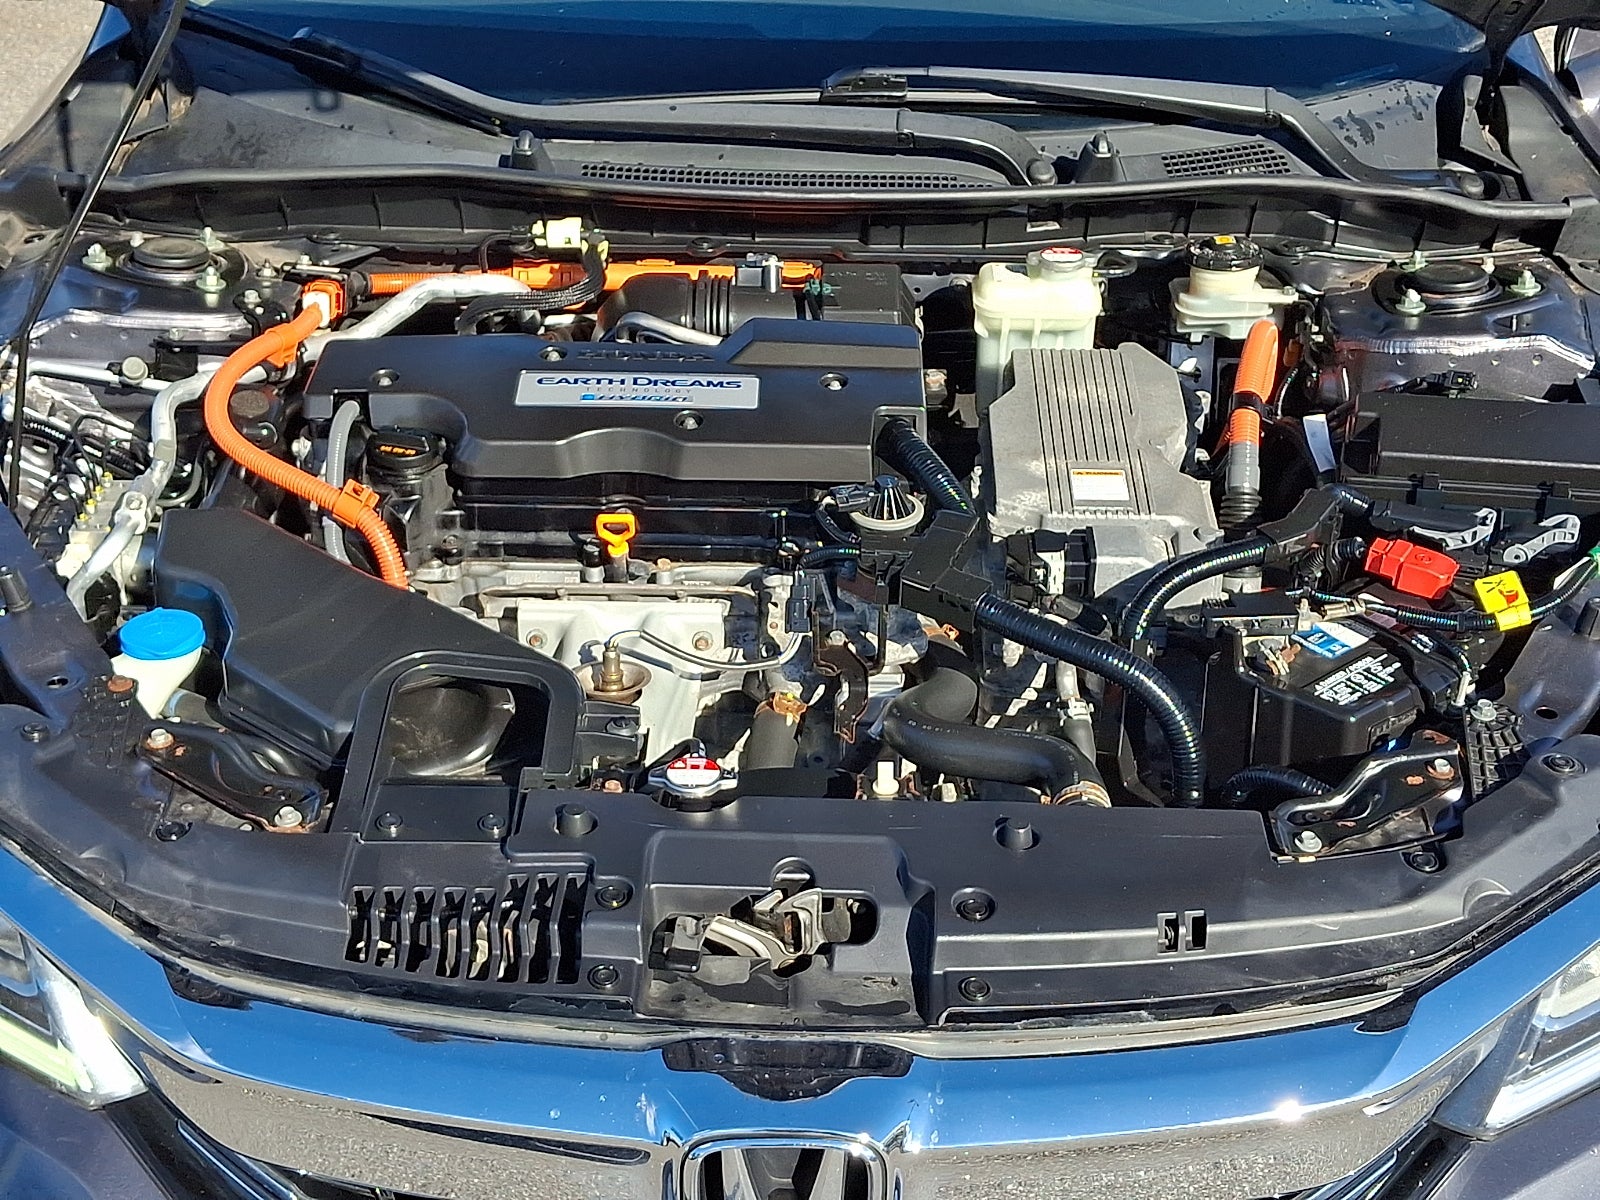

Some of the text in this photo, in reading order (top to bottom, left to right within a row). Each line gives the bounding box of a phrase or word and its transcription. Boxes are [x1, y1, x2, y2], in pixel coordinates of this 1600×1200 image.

[536, 376, 742, 388] EARTH DREAMS
[598, 394, 688, 402] HYBRID
